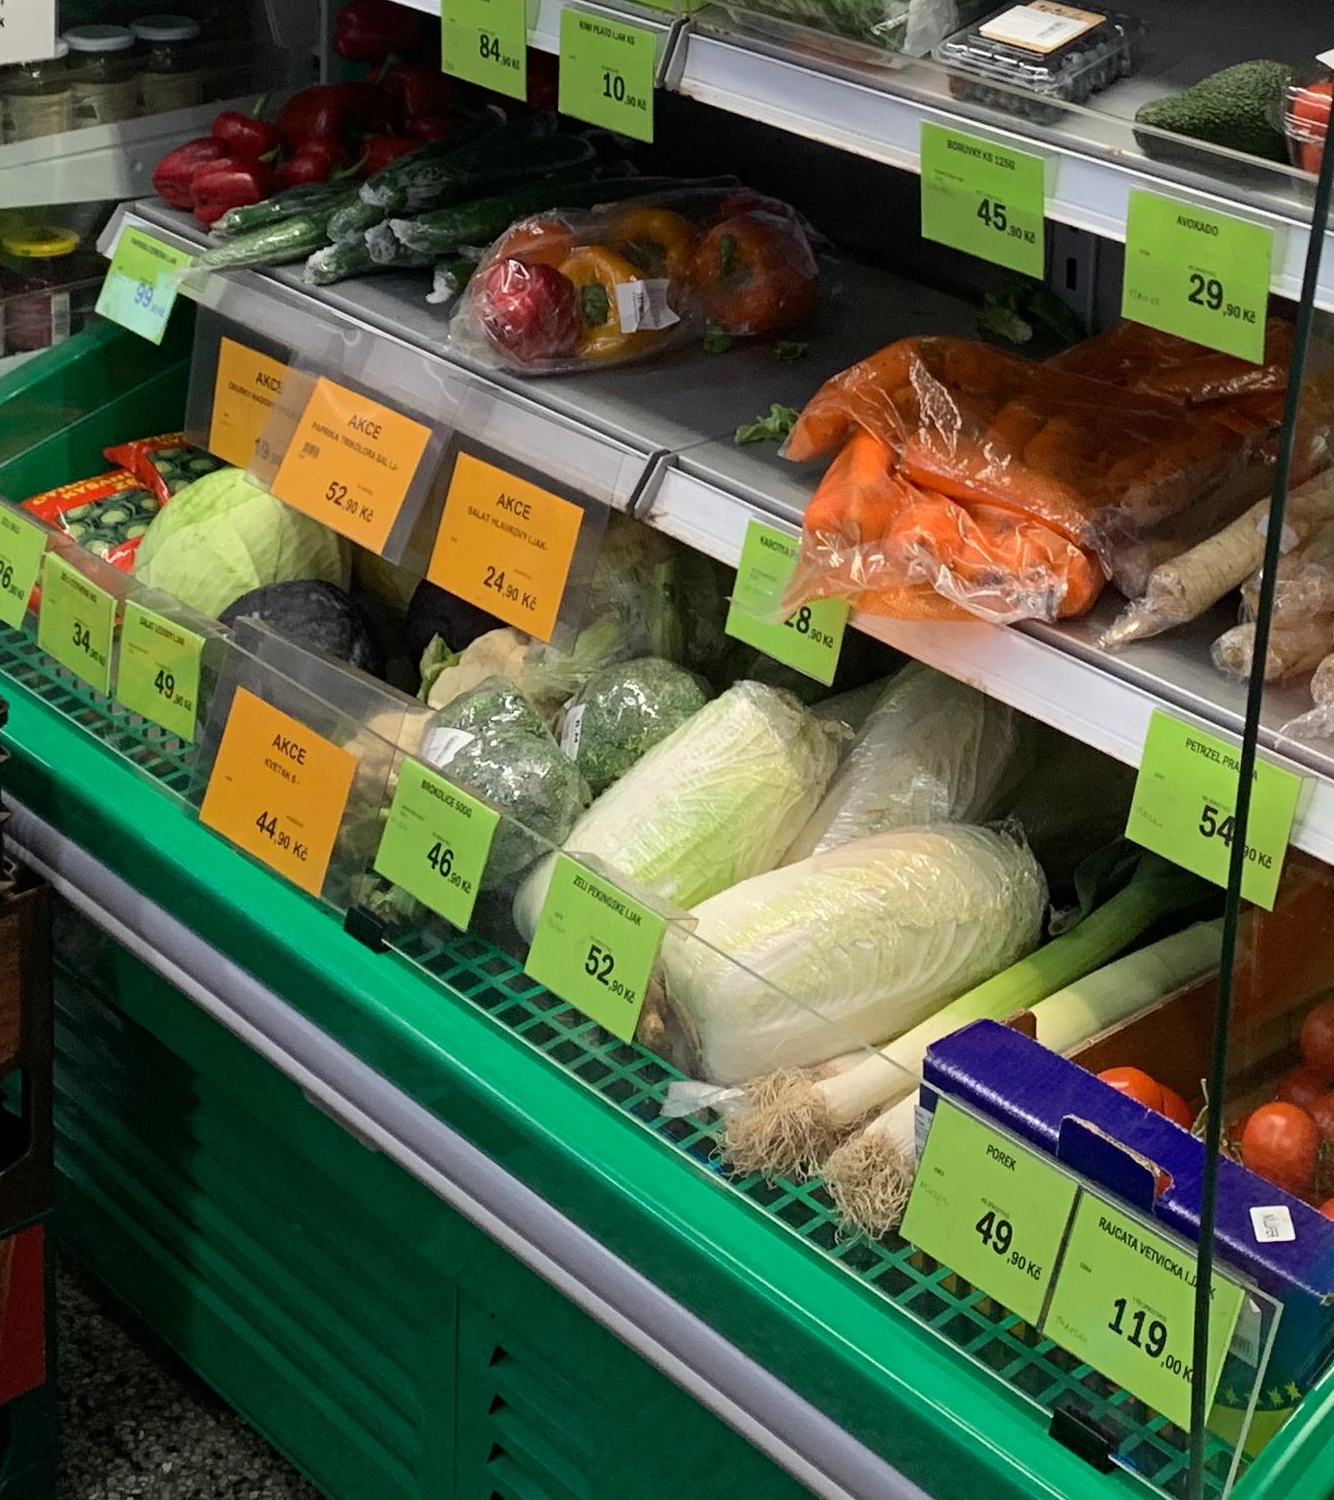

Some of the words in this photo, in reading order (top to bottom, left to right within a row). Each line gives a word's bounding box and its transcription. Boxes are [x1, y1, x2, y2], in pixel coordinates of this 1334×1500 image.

[1177, 215, 1219, 237] AVOKADO
[1187, 273, 1241, 320] 29,90
[1243, 310, 1257, 325] Kč
[347, 414, 382, 441] AKCE
[358, 505, 374, 524] Kč
[467, 505, 490, 524] SALAT
[496, 493, 531, 521] AKCE
[483, 565, 518, 602] 24,90
[521, 590, 537, 612] Kč
[271, 733, 307, 766] AKCE
[1185, 737, 1221, 764] PETRZEL
[1222, 754, 1258, 781] PRAA
[292, 840, 308, 862] Kč
[1257, 851, 1272, 870] Kč
[584, 943, 624, 998] 52,90
[624, 986, 636, 1005] Kč
[986, 1143, 1017, 1172] POREK
[974, 1210, 1026, 1273] 49,90
[1027, 1261, 1042, 1282] Kč
[1098, 1216, 1139, 1253] RAJCATA
[1139, 1242, 1184, 1281] VETVICKA
[1107, 1297, 1183, 1376] 119,00
